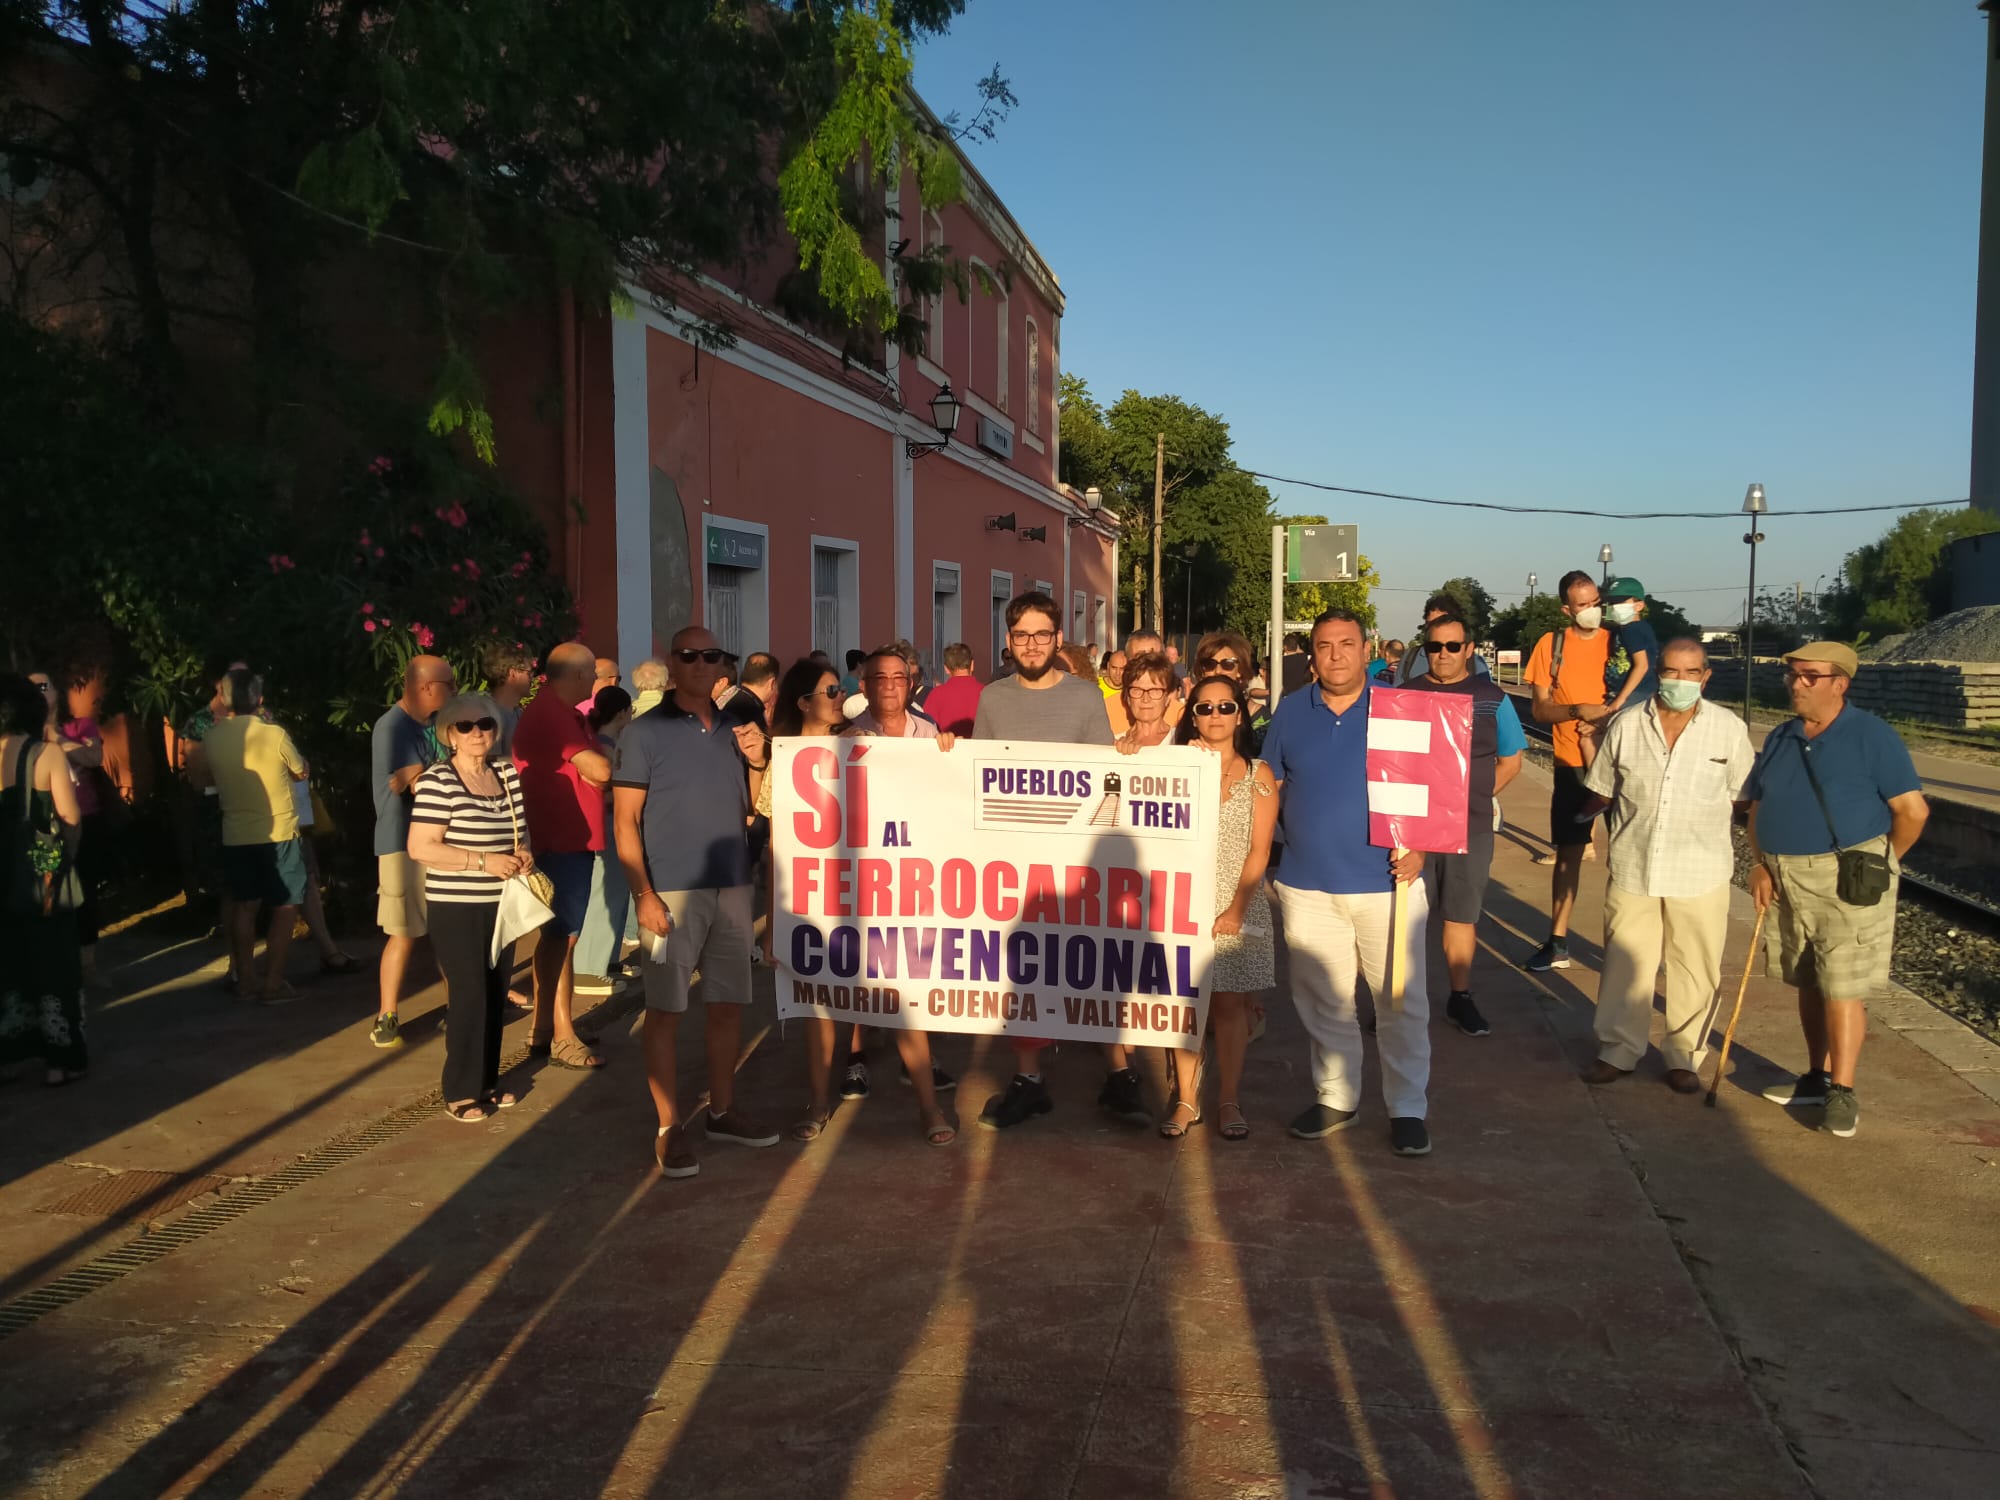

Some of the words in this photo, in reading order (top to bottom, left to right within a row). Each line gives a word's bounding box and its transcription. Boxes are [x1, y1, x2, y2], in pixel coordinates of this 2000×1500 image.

[1336, 551, 1352, 578] 1
[982, 767, 1092, 798] PUEBLOS
[1129, 775, 1167, 797] CON
[1172, 777, 1191, 798] EL
[1128, 800, 1191, 829] TREN
[882, 820, 912, 848] AL
[792, 857, 1199, 936] FERROCARRIL
[791, 924, 1200, 999] CONVENCIONAL
[792, 980, 900, 1016] MADRID
[927, 988, 1038, 1022] CUENCA
[1064, 996, 1198, 1036] VALENCIA
